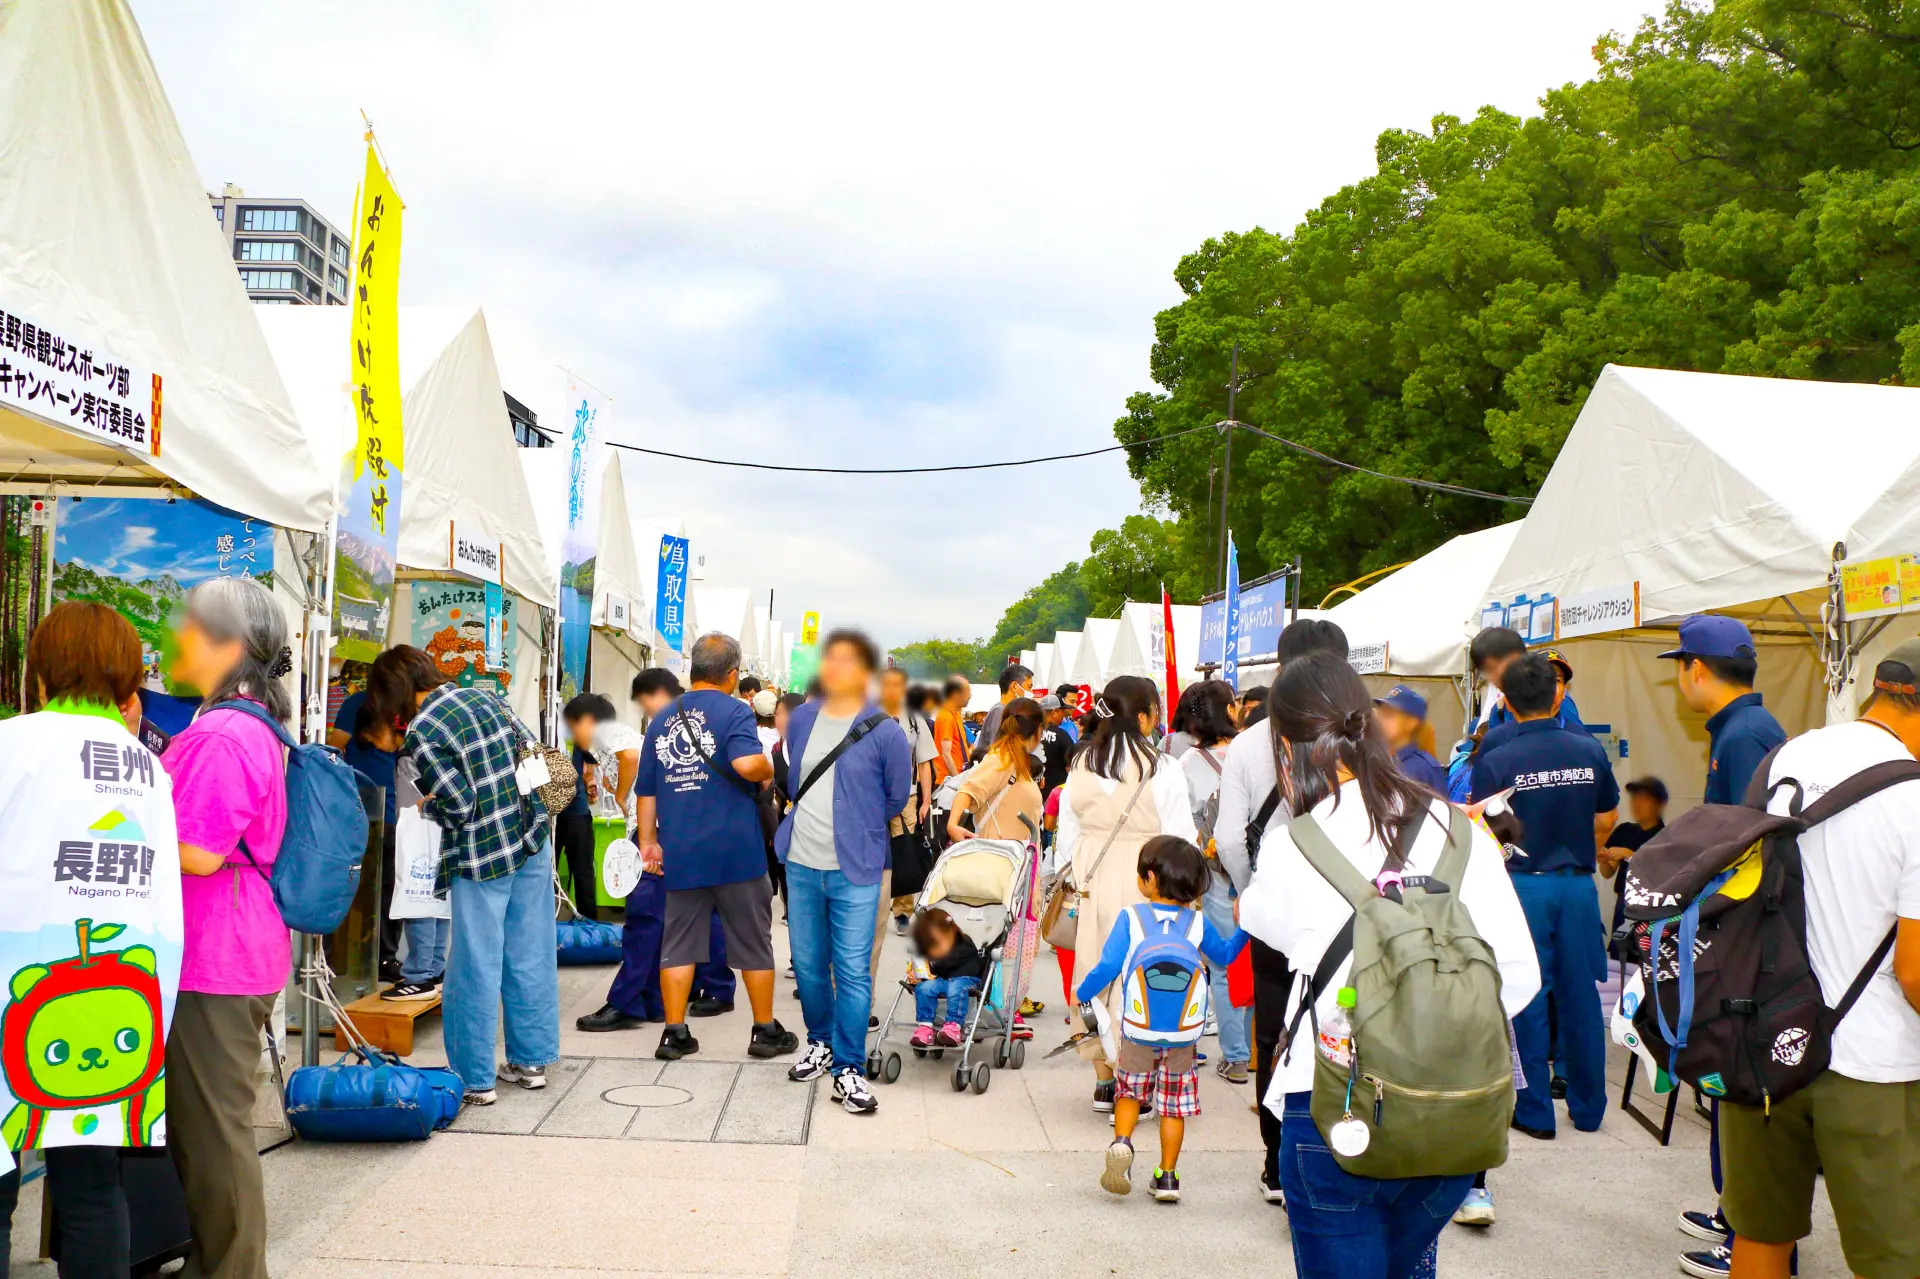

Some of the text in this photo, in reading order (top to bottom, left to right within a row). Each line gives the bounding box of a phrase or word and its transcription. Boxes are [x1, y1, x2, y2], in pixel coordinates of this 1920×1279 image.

[216, 534, 235, 580] 感じ
[418, 590, 512, 616] おんたけスキ場
[664, 543, 685, 636] 鳥取県
[1560, 598, 1633, 627] 消防団チャレンジアクション
[80, 740, 154, 788] 信州
[1514, 767, 1595, 787] 名古屋市消防局
[95, 783, 143, 797] Shinshu
[68, 885, 121, 899] Nagano
[1772, 1033, 1811, 1062] ATHLET
